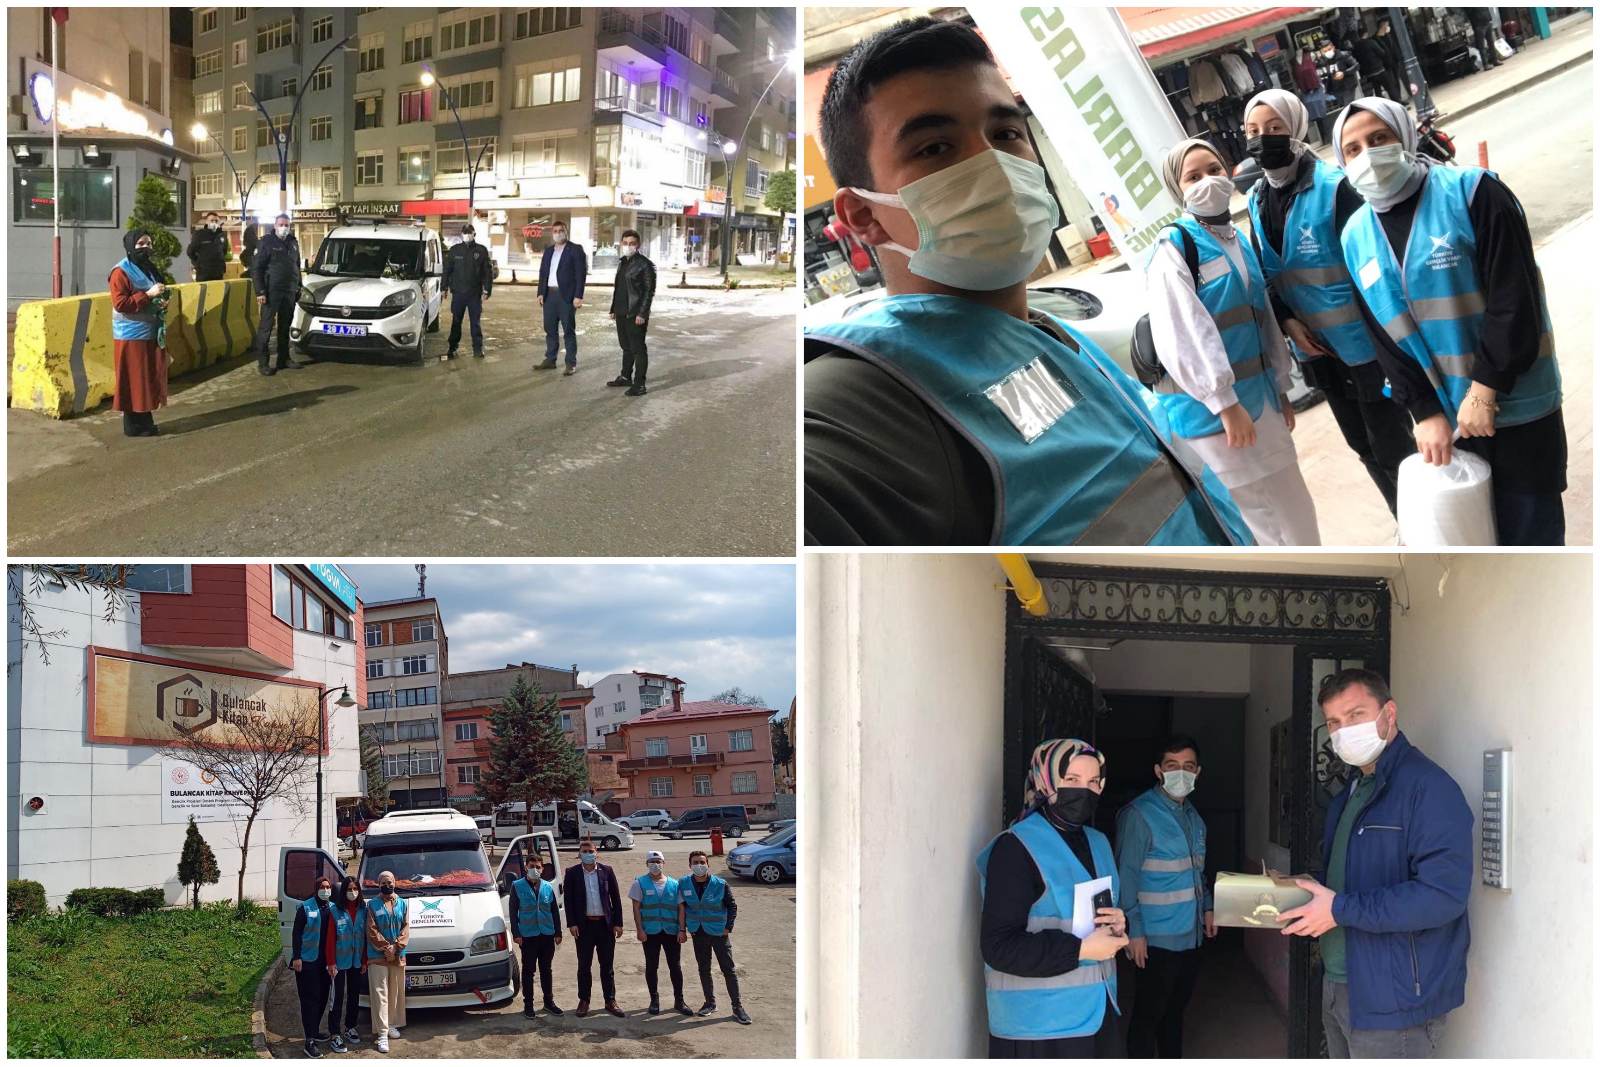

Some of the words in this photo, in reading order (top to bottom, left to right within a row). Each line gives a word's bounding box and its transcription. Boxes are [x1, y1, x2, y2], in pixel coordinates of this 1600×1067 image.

[352, 205, 369, 213] YAPI
[371, 204, 399, 214] İNŞAAT
[222, 693, 267, 712] Bulancak
[222, 709, 248, 726] Kitap
[411, 976, 419, 985] 52
[423, 975, 433, 984] RD
[440, 974, 453, 982] 798
